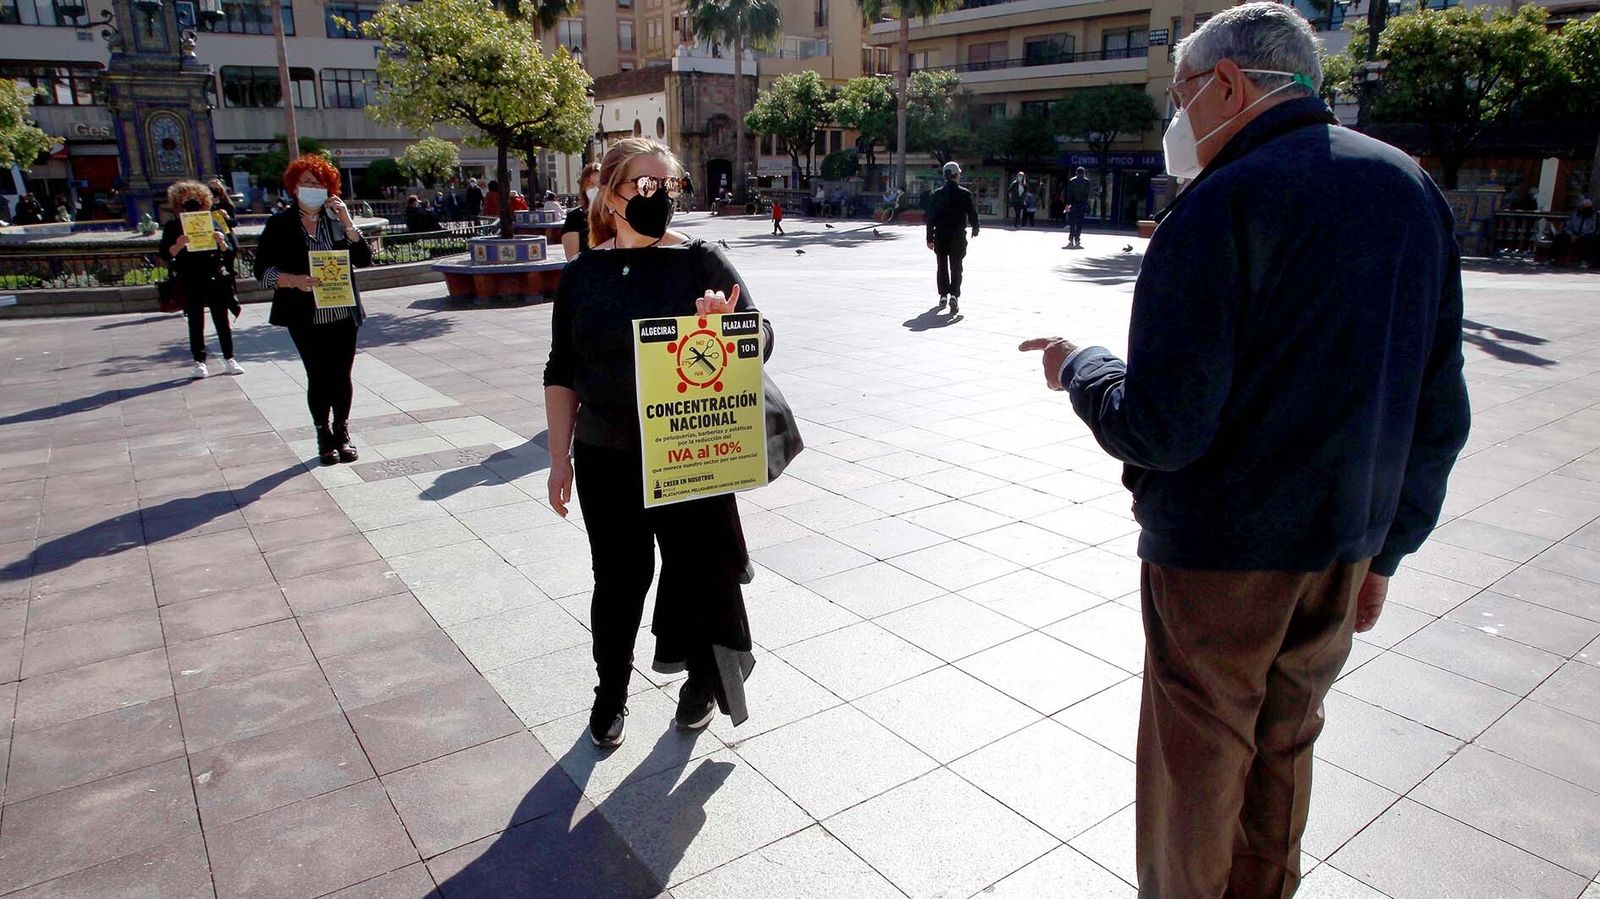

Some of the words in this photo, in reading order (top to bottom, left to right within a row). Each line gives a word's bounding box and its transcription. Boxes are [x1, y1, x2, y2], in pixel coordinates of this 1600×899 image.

[640, 325, 676, 337] ALGECIRAS
[723, 320, 741, 331] PLAZA
[742, 319, 757, 329] ALTA
[741, 344, 750, 353] 10
[750, 344, 756, 352] h
[646, 390, 757, 419] CONCENTRACIÓN
[670, 411, 737, 432] NACIONAL
[668, 447, 693, 463] IVA
[697, 444, 710, 459] al
[713, 440, 742, 456] 10%
[663, 479, 680, 487] CREER
[687, 474, 715, 483] NOSOTROS
